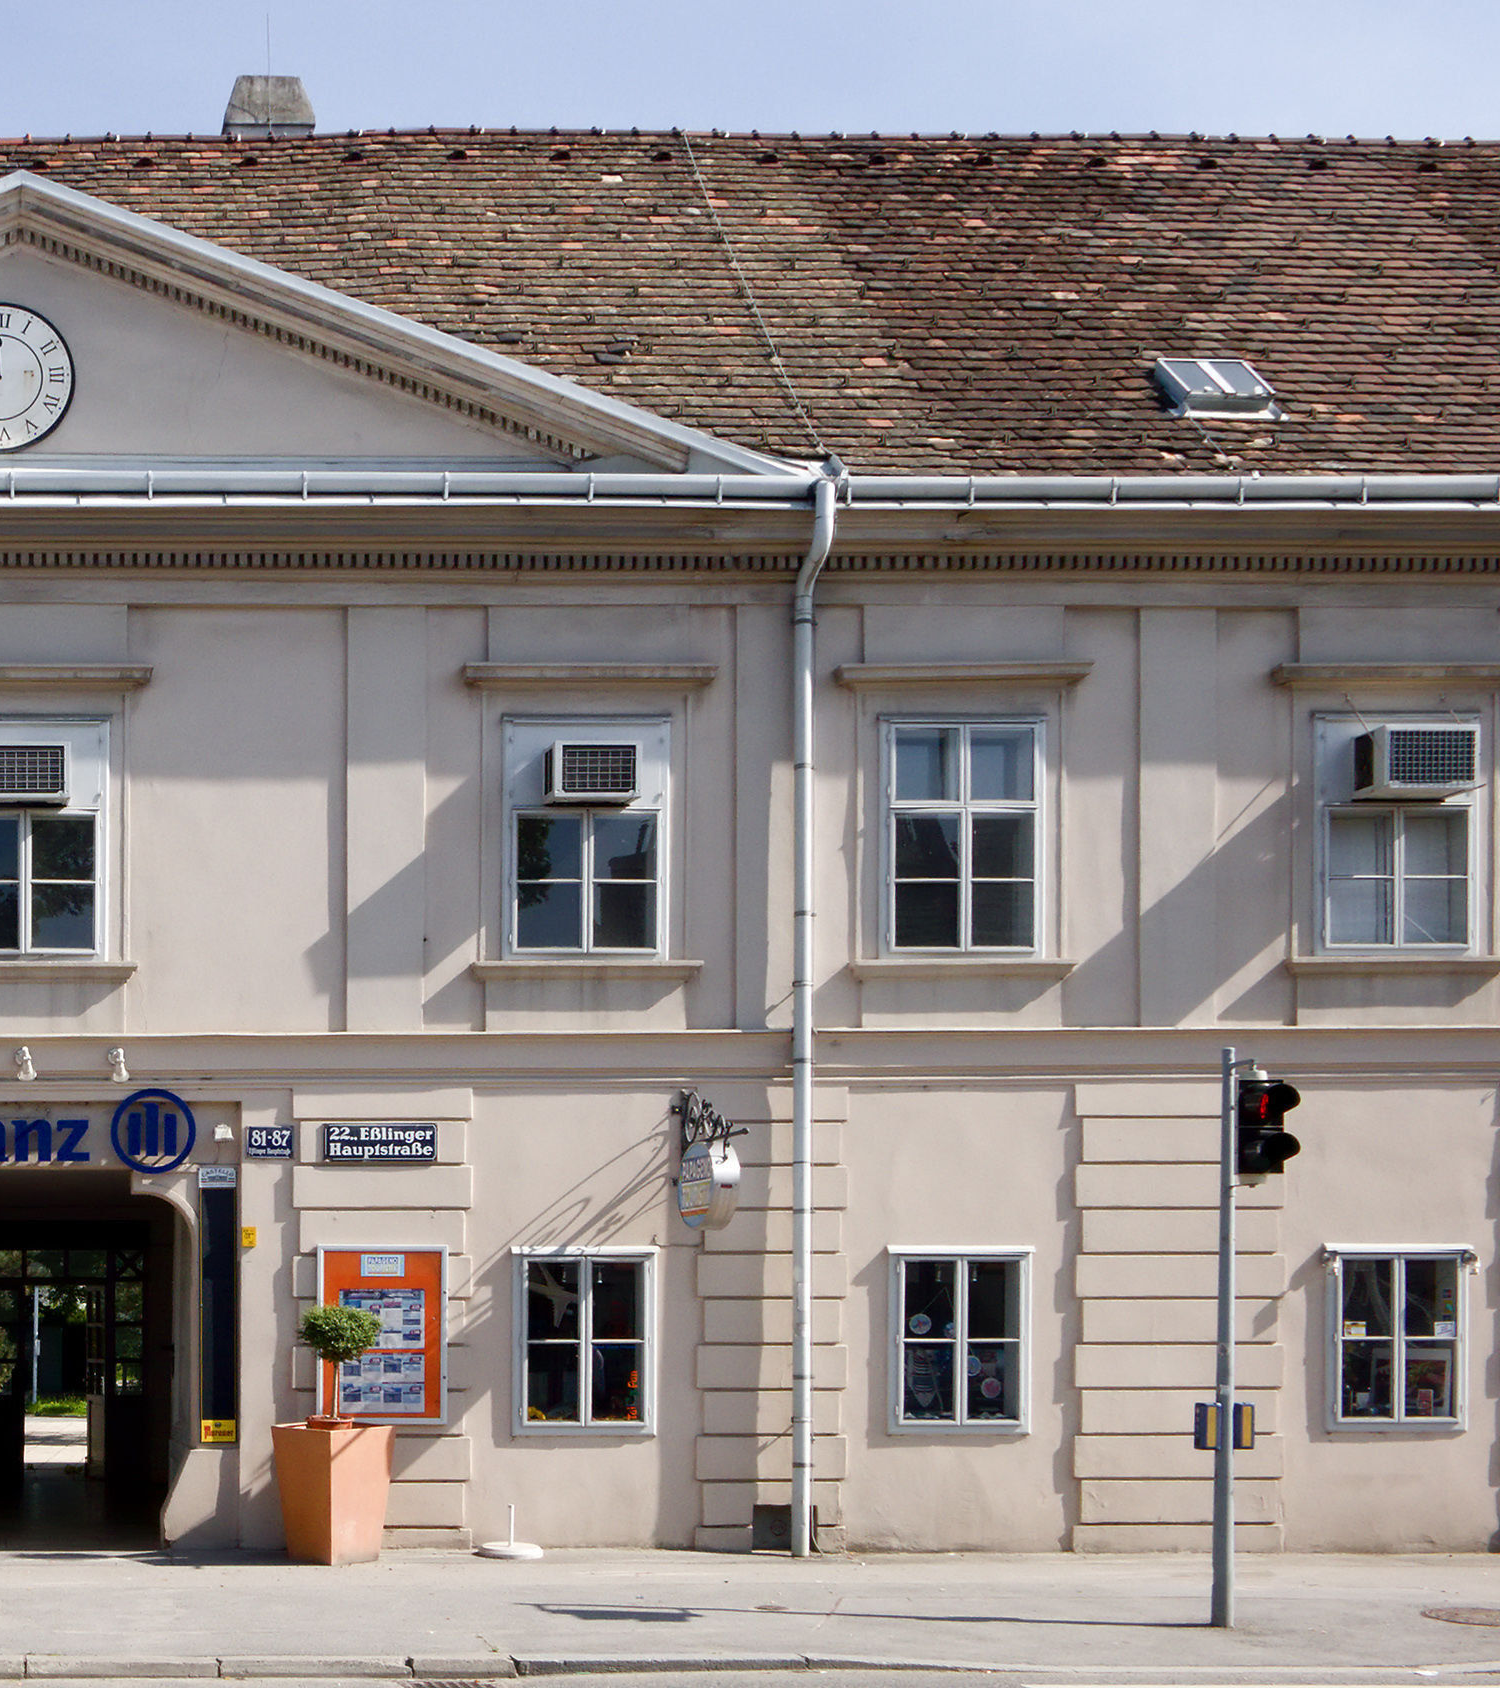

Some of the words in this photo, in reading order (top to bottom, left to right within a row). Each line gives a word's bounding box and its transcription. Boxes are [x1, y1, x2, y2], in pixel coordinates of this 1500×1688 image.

[21, 320, 31, 335] I
[40, 339, 58, 356] II
[49, 366, 64, 383] III
[43, 394, 60, 415] IV
[25, 419, 39, 435] V
[251, 1129, 290, 1146] 81-87
[359, 1127, 434, 1144] Eßlinger
[329, 1142, 434, 1160] Hauptstraße
